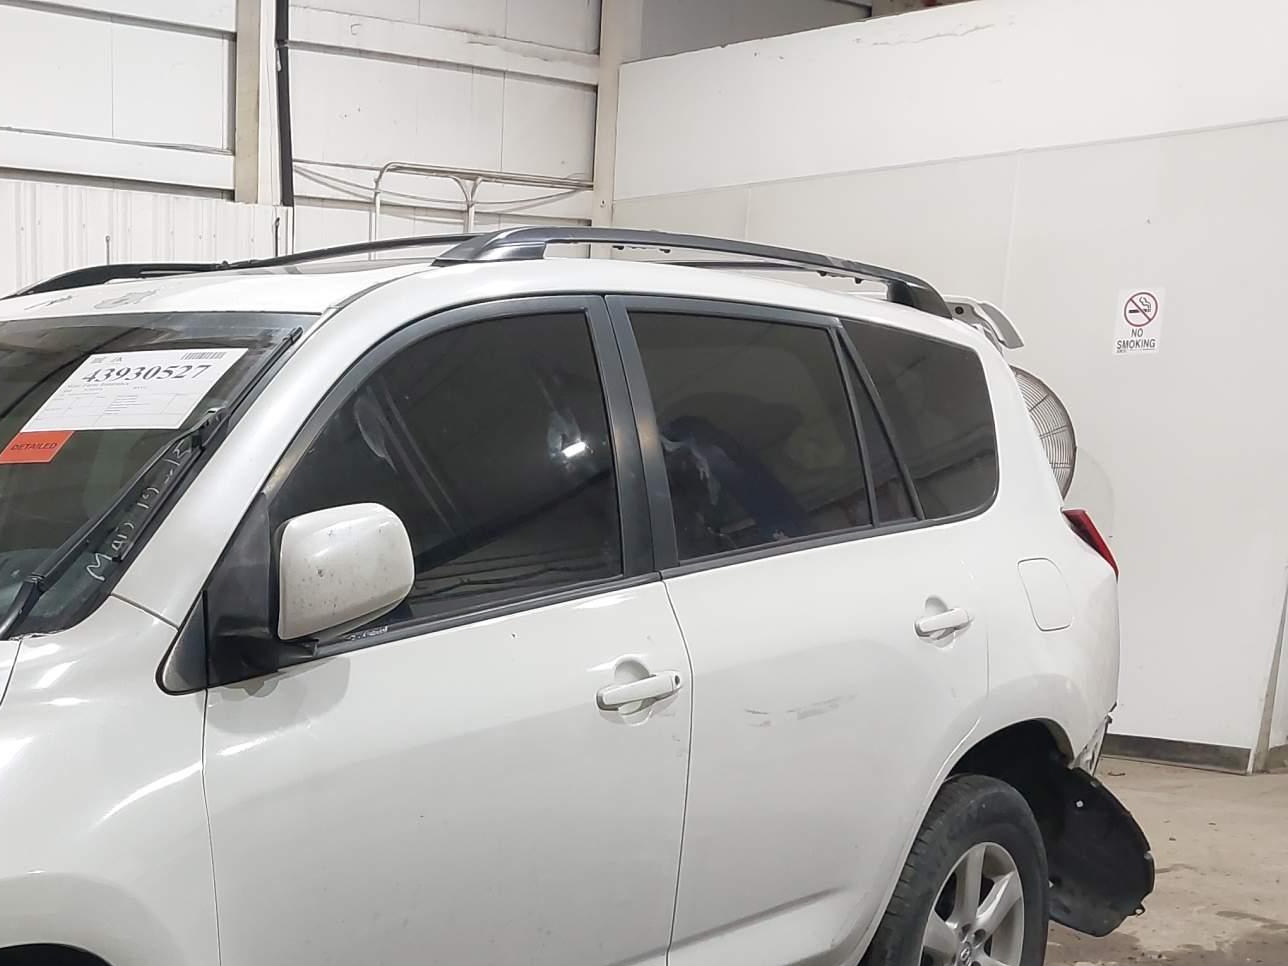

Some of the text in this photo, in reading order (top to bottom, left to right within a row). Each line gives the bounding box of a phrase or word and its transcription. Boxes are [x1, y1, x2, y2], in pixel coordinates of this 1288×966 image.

[1131, 328, 1144, 337] NO
[1116, 339, 1156, 349] SMOKING
[82, 364, 212, 383] 43930527
[11, 442, 58, 451] DETAILED
